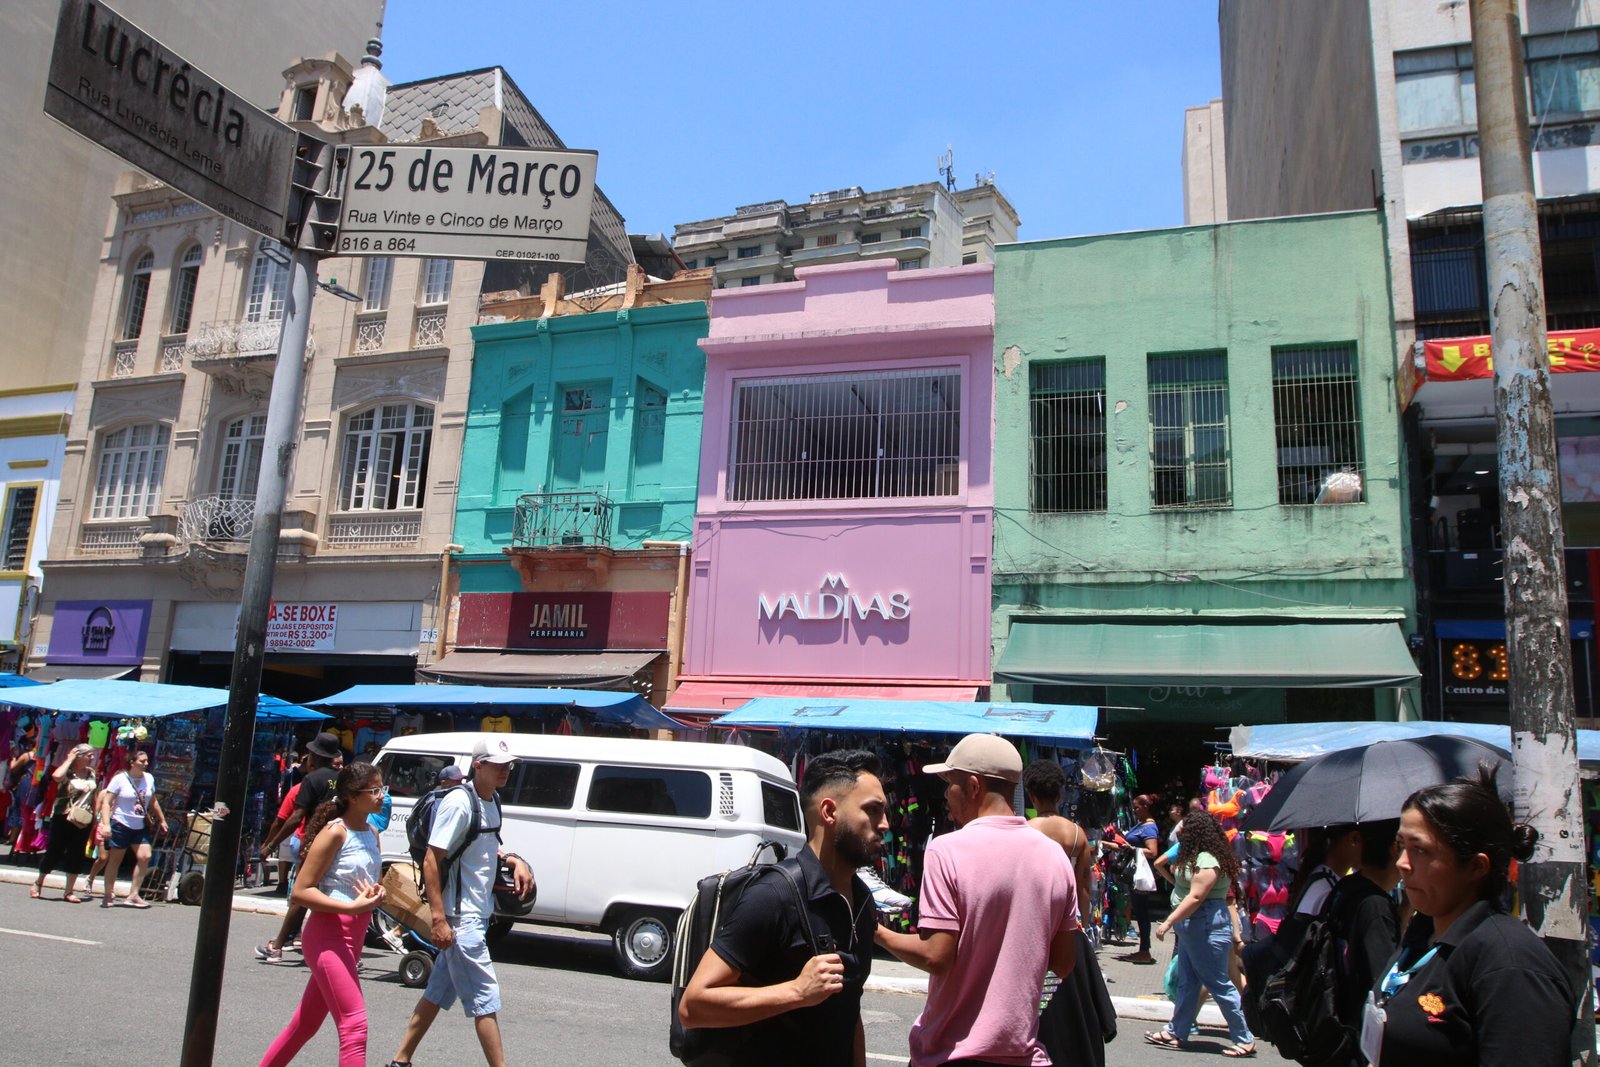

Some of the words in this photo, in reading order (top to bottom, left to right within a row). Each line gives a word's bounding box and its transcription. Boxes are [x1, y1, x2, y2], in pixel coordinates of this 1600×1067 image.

[82, 2, 245, 149] Lucrécia
[78, 76, 110, 108] Rua
[116, 100, 178, 148] Lucrécia
[184, 140, 222, 174] Leme
[354, 150, 396, 192] 25
[408, 149, 453, 193] de
[467, 154, 581, 209] Março
[348, 209, 377, 224] Rua
[383, 210, 420, 225] Vinte
[425, 215, 435, 226] e
[440, 212, 484, 228] Cinco
[489, 214, 509, 229] de
[514, 215, 563, 233] Março
[341, 237, 369, 251] 816
[373, 240, 383, 251] a
[387, 238, 416, 251] 864
[495, 249, 514, 258] CEP
[516, 250, 560, 261] 01021-100
[300, 605, 327, 621] BOX
[328, 605, 337, 621] E
[757, 591, 911, 620] MALDIVAS
[529, 604, 588, 628] JAMIL
[270, 639, 316, 648] 98942-0002
[287, 630, 300, 640] R$
[301, 630, 327, 640] 3.300
[422, 630, 438, 640] 795
[1452, 643, 1510, 681] 81
[1445, 685, 1484, 695] Centro
[1485, 685, 1506, 695] das
